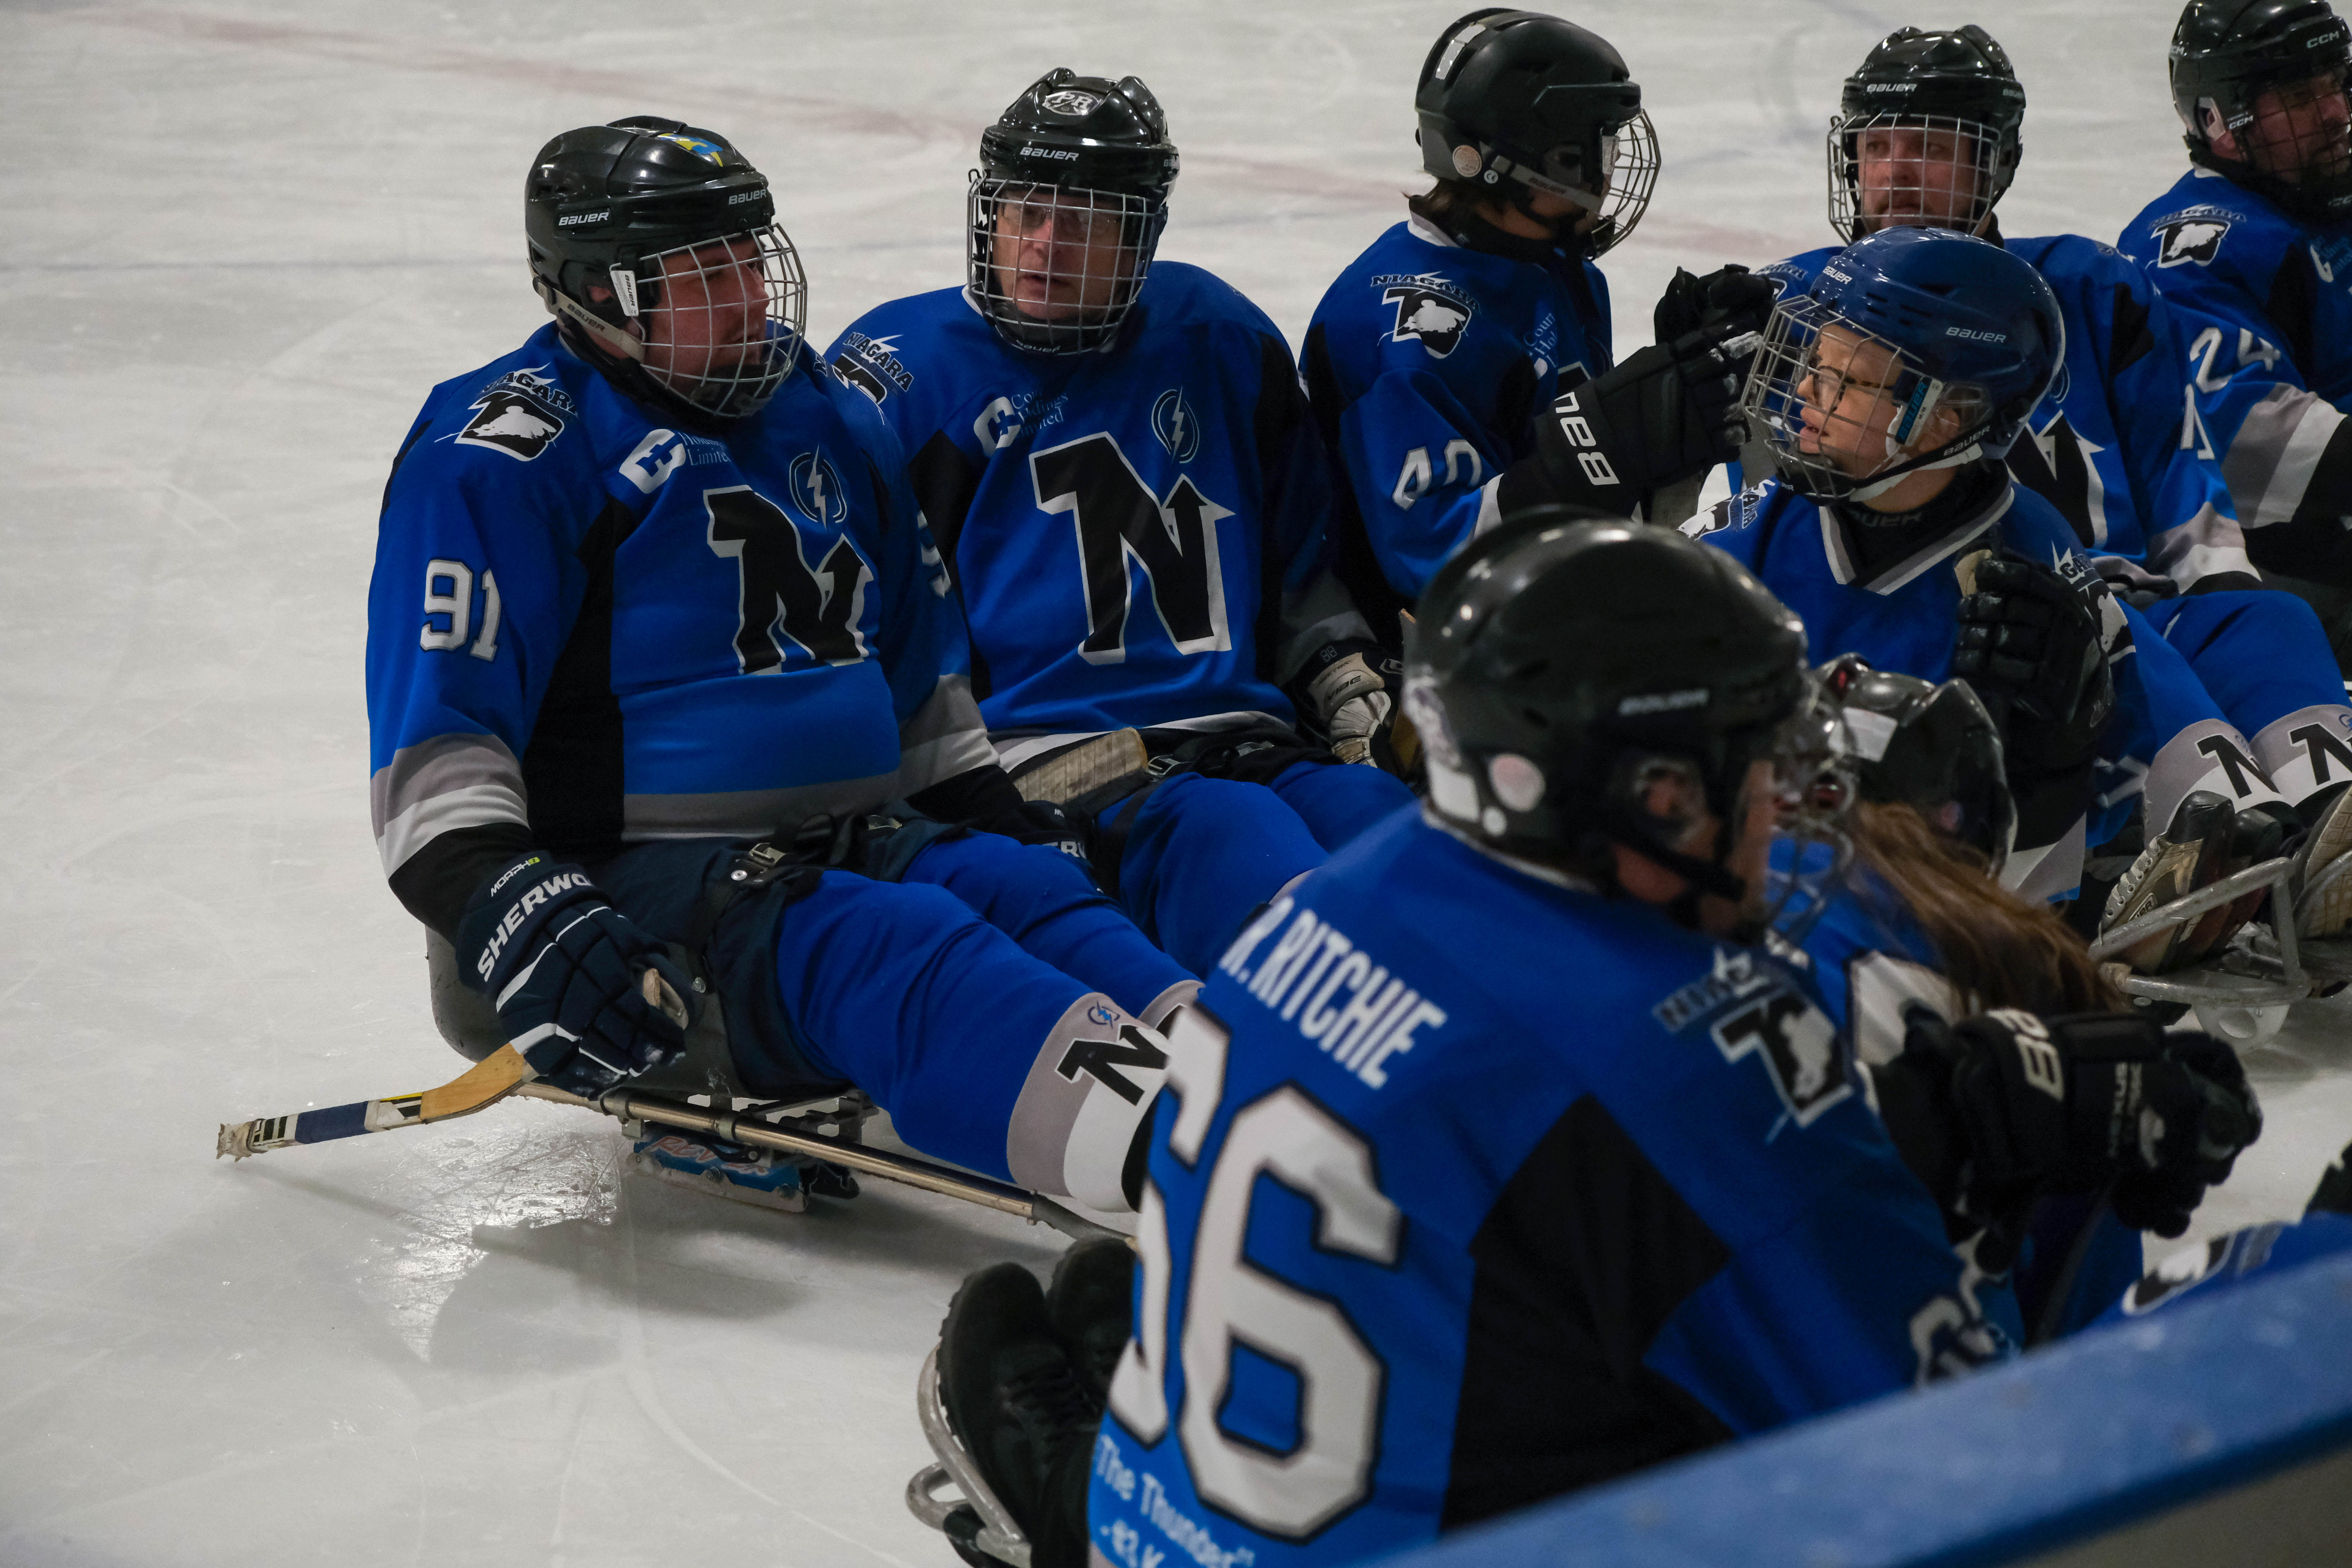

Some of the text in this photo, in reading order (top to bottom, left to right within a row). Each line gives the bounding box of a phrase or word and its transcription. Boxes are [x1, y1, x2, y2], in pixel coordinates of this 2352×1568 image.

[2307, 31, 2339, 49] CCM
[2229, 115, 2254, 129] CCM
[1020, 146, 1079, 161] BAUER
[729, 189, 767, 205] BAUER
[558, 211, 609, 226] BAUER
[1822, 266, 1853, 285] BAUER
[625, 274, 635, 306] BAUER
[1370, 274, 1482, 314] NIAGARA
[567, 303, 605, 331] BAUER
[1946, 326, 2006, 343] BAUER
[843, 332, 914, 392] NIAGARA
[2189, 327, 2281, 394] 24
[1943, 426, 1990, 456] BAUER
[420, 558, 502, 662] 91
[491, 860, 531, 897] MORPH
